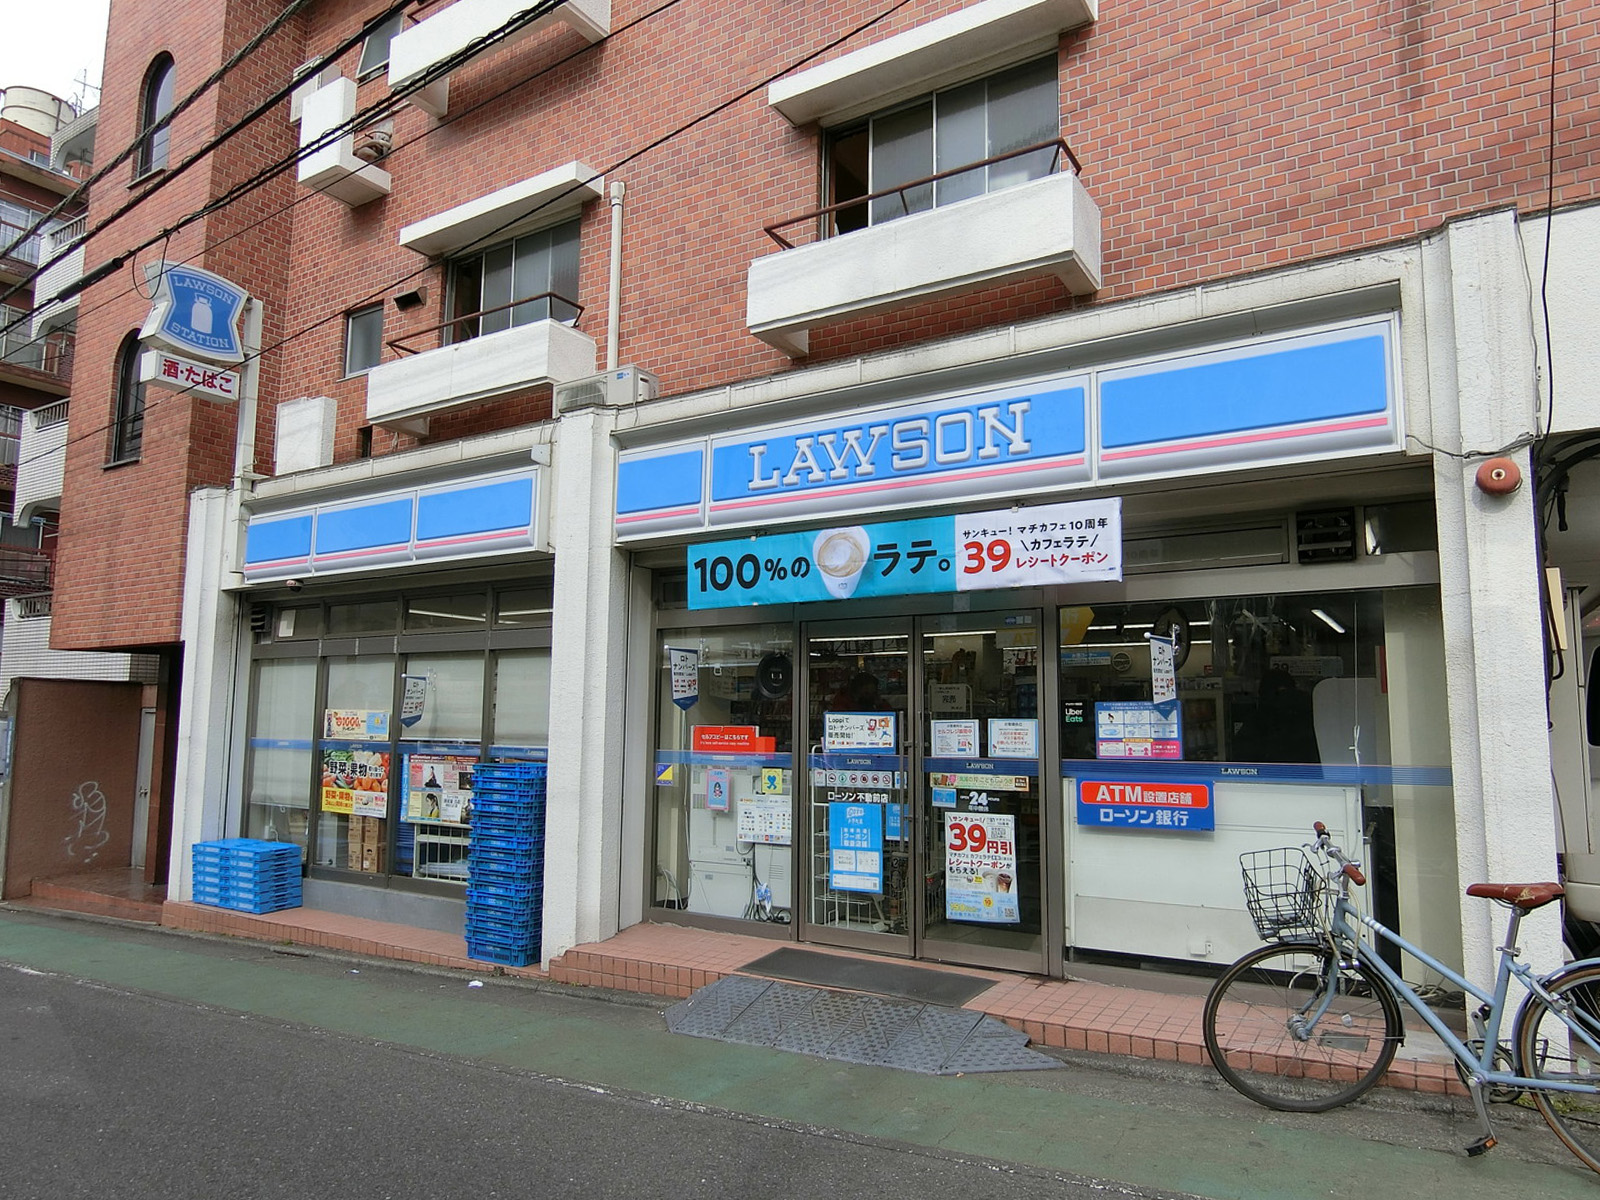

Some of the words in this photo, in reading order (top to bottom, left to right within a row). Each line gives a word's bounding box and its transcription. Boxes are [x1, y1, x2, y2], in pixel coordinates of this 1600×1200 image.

[173, 276, 234, 305] LAWSON
[171, 322, 230, 349] STATION
[748, 401, 1032, 491] LAWSON
[1016, 517, 1109, 535] マチカフェ10周年
[963, 539, 1012, 575] 39
[1016, 551, 1109, 569] レシートクーポン
[693, 553, 811, 593] 100%の
[873, 540, 951, 577] ラテ。
[1065, 708, 1083, 716] Uber
[1221, 767, 1258, 775] LAWSON
[969, 791, 989, 806] 24
[1096, 785, 1193, 805] ATM設置店舗
[1100, 808, 1190, 827] ローソン銀行
[949, 858, 1012, 869] レシートクーポンが
[949, 866, 979, 875] もらえる!
